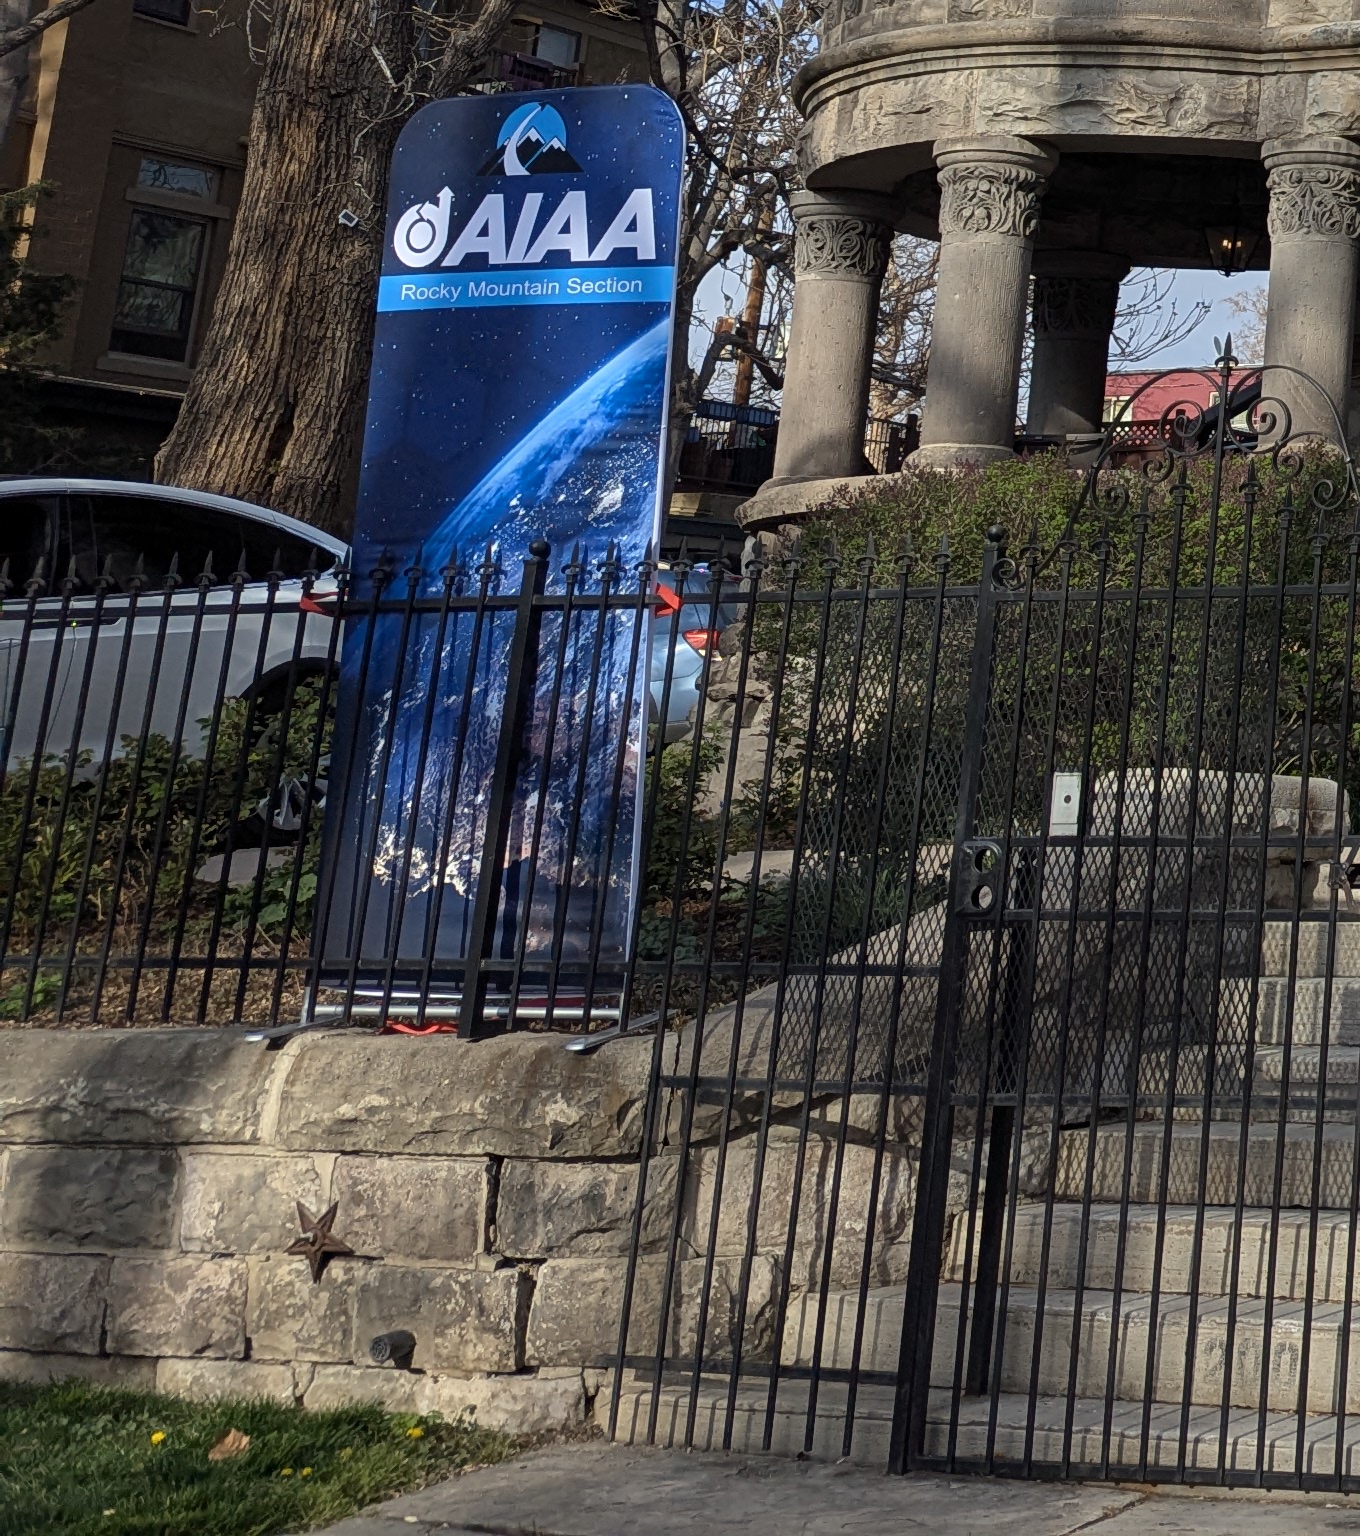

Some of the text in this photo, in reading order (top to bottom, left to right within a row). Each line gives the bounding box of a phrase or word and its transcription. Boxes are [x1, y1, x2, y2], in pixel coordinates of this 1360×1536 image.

[441, 188, 657, 267] AIAA
[400, 276, 643, 303] Rocky Mountain Section
